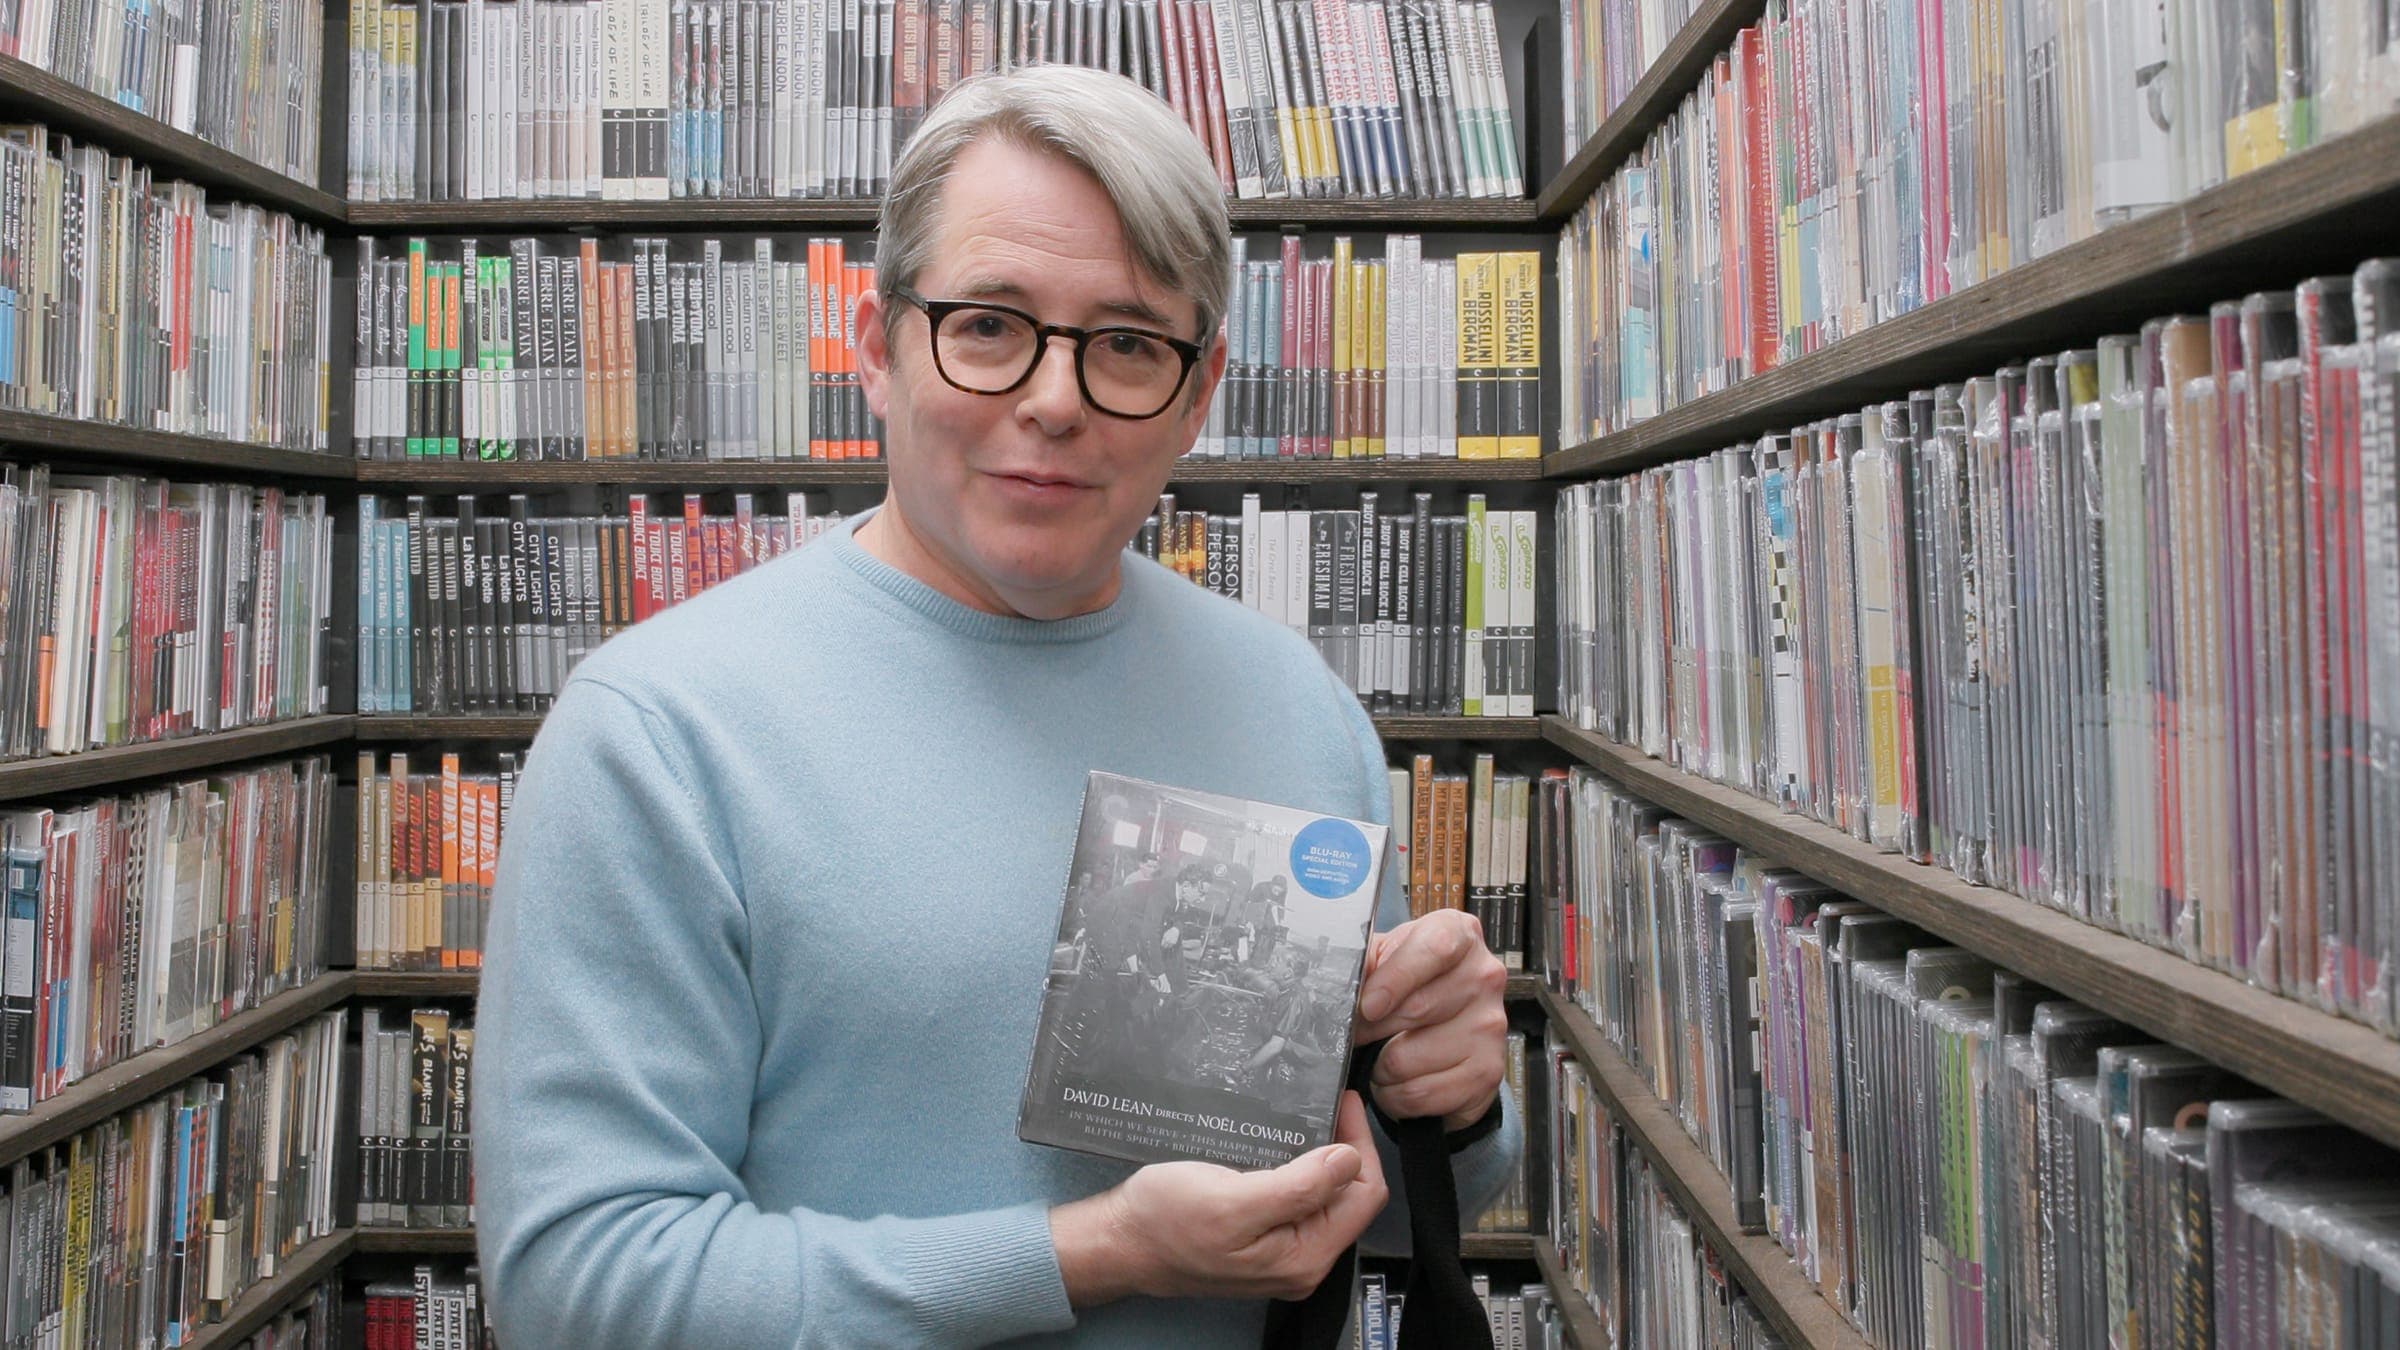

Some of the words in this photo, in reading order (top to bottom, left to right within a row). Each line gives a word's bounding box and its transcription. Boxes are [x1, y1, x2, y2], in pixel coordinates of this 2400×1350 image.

[776, 0, 788, 51] PURPLE
[794, 6, 806, 58] PURPLE
[811, 2, 823, 55] PURPLE
[903, 45, 917, 84] TRILOGY
[1219, 20, 1240, 80] WATERFRONT
[1246, 37, 1268, 97] WATERFRONT
[643, 73, 651, 97] LIFE
[776, 57, 787, 93] NOON
[794, 64, 805, 99] NOON
[811, 60, 823, 96] NOON
[1430, 52, 1450, 97] ESCAPED
[516, 252, 529, 305] PIERRE
[706, 252, 717, 301] medium
[758, 251, 769, 274] LIFE
[562, 260, 575, 313] PIERRE
[759, 279, 769, 290] IS
[637, 285, 650, 320] YUMA
[655, 285, 668, 320] YUMA
[707, 303, 718, 330] cool
[758, 295, 770, 335] SWEET
[777, 308, 788, 318] IS
[795, 306, 805, 317] IS
[518, 311, 532, 357] ETAIX
[542, 319, 555, 363] ETAIX
[564, 319, 577, 363] ETAIX
[673, 308, 685, 343] YUMA
[690, 309, 703, 344] YUMA
[726, 328, 736, 354] cool
[743, 326, 754, 352] cool
[777, 323, 788, 362] SWEET
[795, 322, 806, 361] SWEET
[1463, 300, 1478, 363] BERGMAN
[1478, 292, 1492, 363] ROSSELLINI
[1504, 300, 1519, 363] BERGMAN
[1520, 291, 1534, 363] ROSSELLINI
[409, 511, 420, 528] THE
[632, 510, 645, 544] TOUKI
[1363, 504, 1373, 525] RIOT
[427, 537, 438, 553] THE
[443, 536, 454, 553] THE
[463, 536, 474, 552] La
[513, 522, 524, 552] CITY
[649, 529, 662, 564] TOUKI
[670, 530, 683, 564] TOUKI
[1362, 539, 1373, 559] CELL
[1363, 528, 1373, 537] IN
[1380, 525, 1391, 546] RIOT
[1399, 529, 1410, 551] RIOT
[481, 555, 492, 570] La
[499, 555, 509, 570] La
[529, 534, 540, 566] CITY
[548, 536, 559, 567] CITY
[634, 546, 647, 580] BOUKI
[1225, 535, 1239, 599] PERSON
[1381, 548, 1391, 559] IN
[1399, 553, 1409, 563] IN
[464, 554, 475, 587] Notte
[514, 557, 526, 602] LIGHTS
[651, 566, 664, 600] BOUKI
[672, 566, 685, 600] BOUKI
[1314, 543, 1331, 609] FRESHMAN
[1339, 546, 1355, 612] FRESHMAN
[1362, 560, 1372, 586] BLOCK
[1379, 560, 1390, 580] CELL
[1398, 565, 1409, 584] CELL
[482, 572, 493, 603] Notte
[500, 572, 511, 603] Notte
[530, 570, 543, 614] LIGHTS
[549, 572, 562, 616] LIGHTS
[1379, 581, 1389, 608] BLOCK
[1398, 586, 1408, 612] BLOCK
[461, 790, 477, 870] JUDEX
[480, 794, 497, 876] JUDEX
[1302, 855, 1328, 864] SPECIAL
[1310, 846, 1352, 859] BLU-RAY
[419, 1027, 436, 1053] LES
[452, 1035, 468, 1061] LES
[1063, 1088, 1109, 1108] DAVID
[1112, 1097, 1153, 1116] LEAN
[1155, 1108, 1194, 1123] DIRECTS
[1197, 1114, 1237, 1134] NOËL
[1240, 1123, 1306, 1146] COWARD
[1069, 1111, 1082, 1120] IN
[1085, 1114, 1123, 1127] WHICH
[1127, 1121, 1143, 1131] WE
[1147, 1125, 1178, 1139] SERVE
[1190, 1133, 1216, 1146] THIS
[1219, 1139, 1254, 1153] HAPPY
[1258, 1146, 1292, 1161] BREED
[1084, 1126, 1122, 1140] BLITHE
[1126, 1134, 1161, 1147] SPIRIT
[1172, 1143, 1200, 1156] BRIEF
[1205, 1149, 1272, 1169] ENCOUNTER
[415, 1276, 429, 1324] STATE
[1493, 1310, 1505, 1324] In
[434, 1298, 445, 1338] STATE
[450, 1300, 461, 1339] STATE
[1511, 1311, 1522, 1324] In
[415, 1327, 429, 1347] OF
